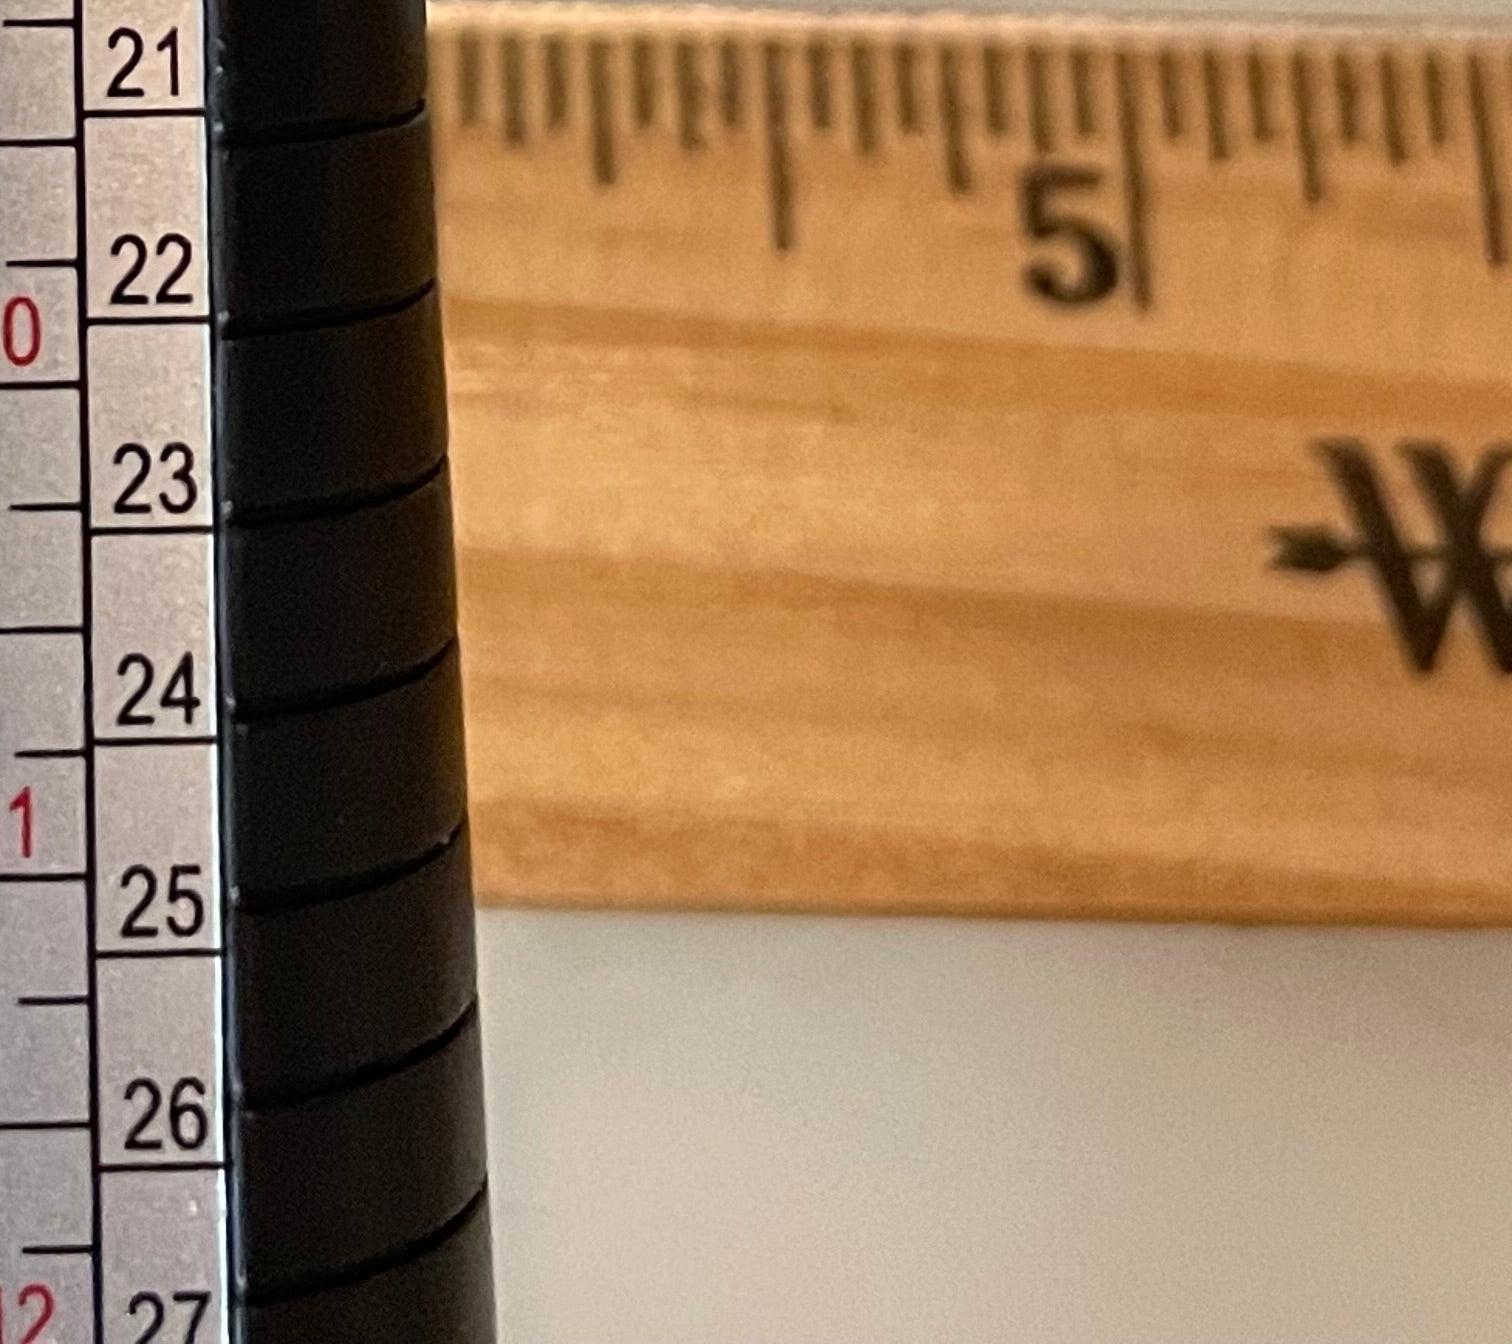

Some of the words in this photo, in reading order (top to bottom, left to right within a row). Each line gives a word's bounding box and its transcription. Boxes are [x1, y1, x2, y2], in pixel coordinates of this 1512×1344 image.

[107, 27, 179, 97] 21
[109, 233, 194, 305] 22
[1018, 162, 1120, 306] 5
[112, 443, 198, 514] 23
[116, 652, 200, 725] 24
[120, 864, 204, 937] 25
[123, 1078, 208, 1149] 26
[128, 1291, 211, 1344] 27
